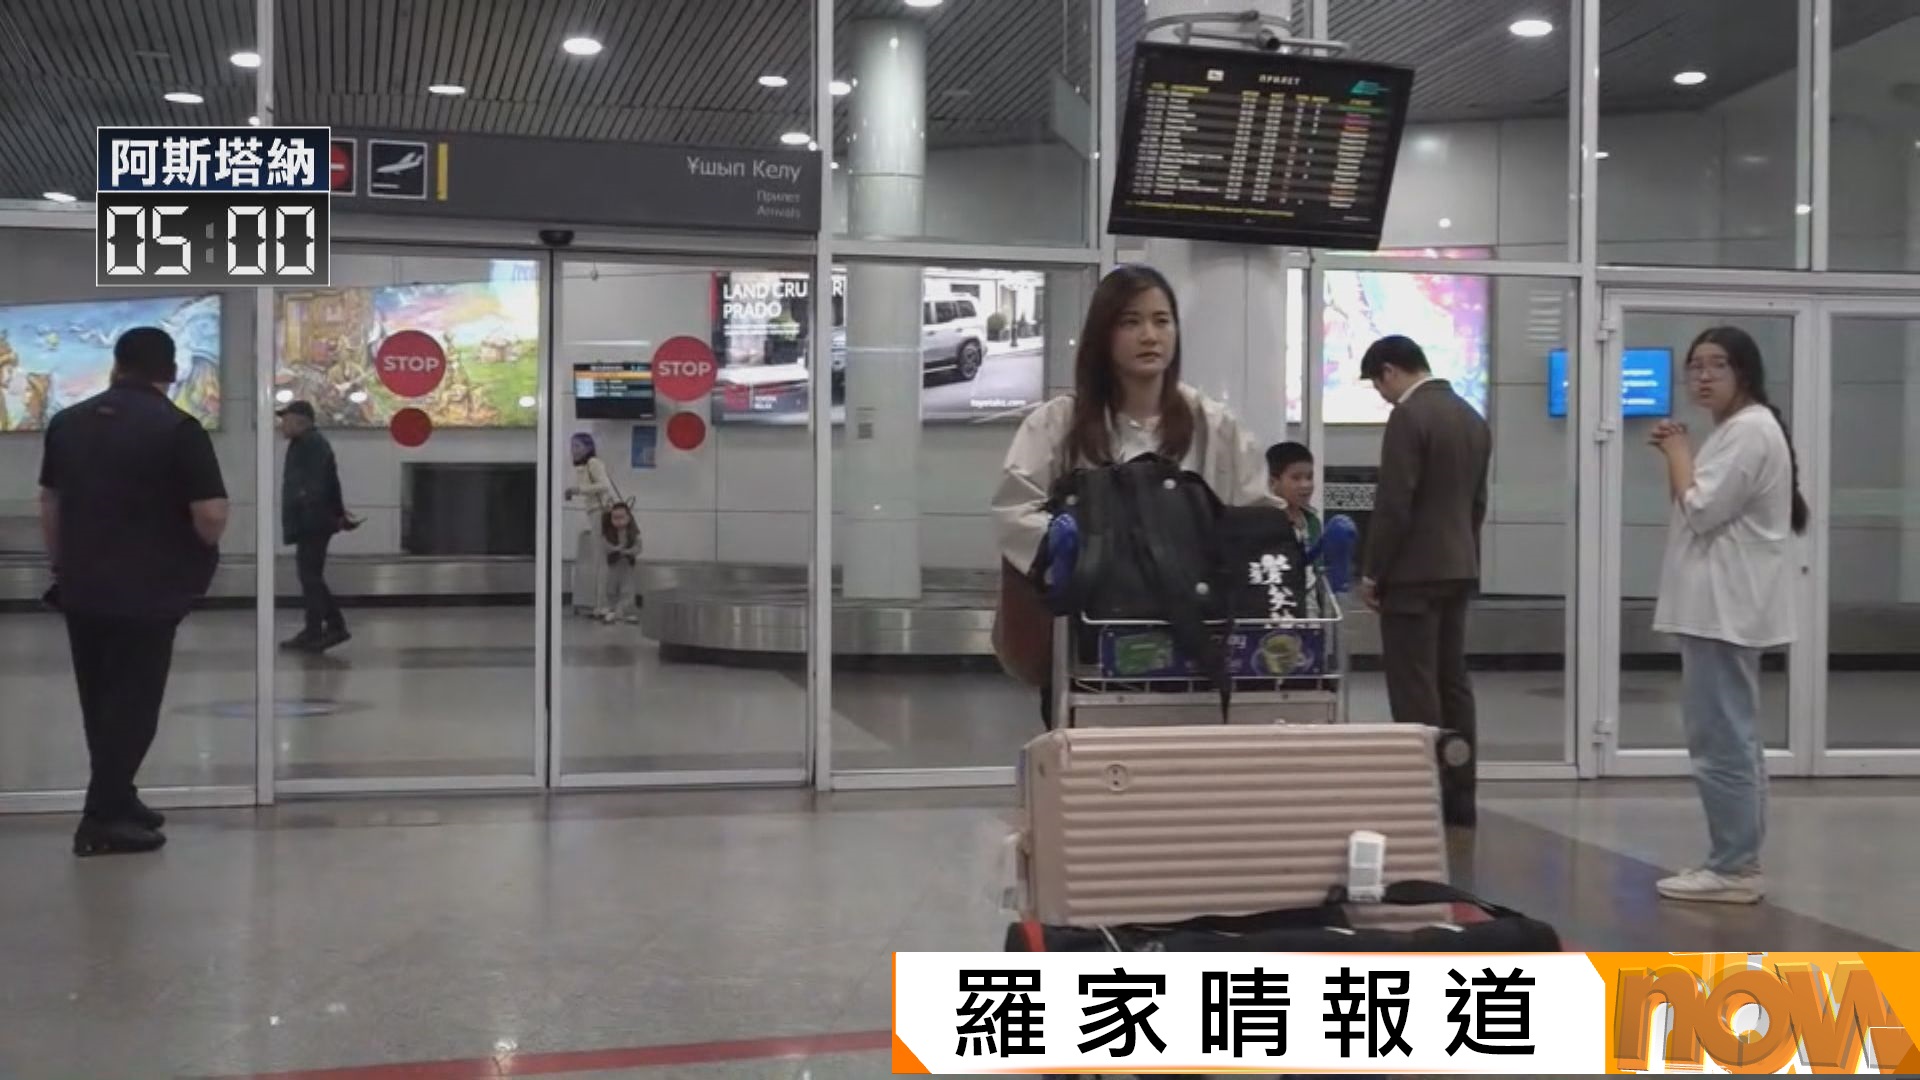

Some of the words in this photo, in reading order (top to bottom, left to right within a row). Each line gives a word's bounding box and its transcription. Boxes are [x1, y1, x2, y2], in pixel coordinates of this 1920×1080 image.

[722, 282, 768, 300] LAND
[722, 302, 782, 319] PRADO
[383, 355, 440, 372] STOP
[658, 361, 712, 376] STOP
